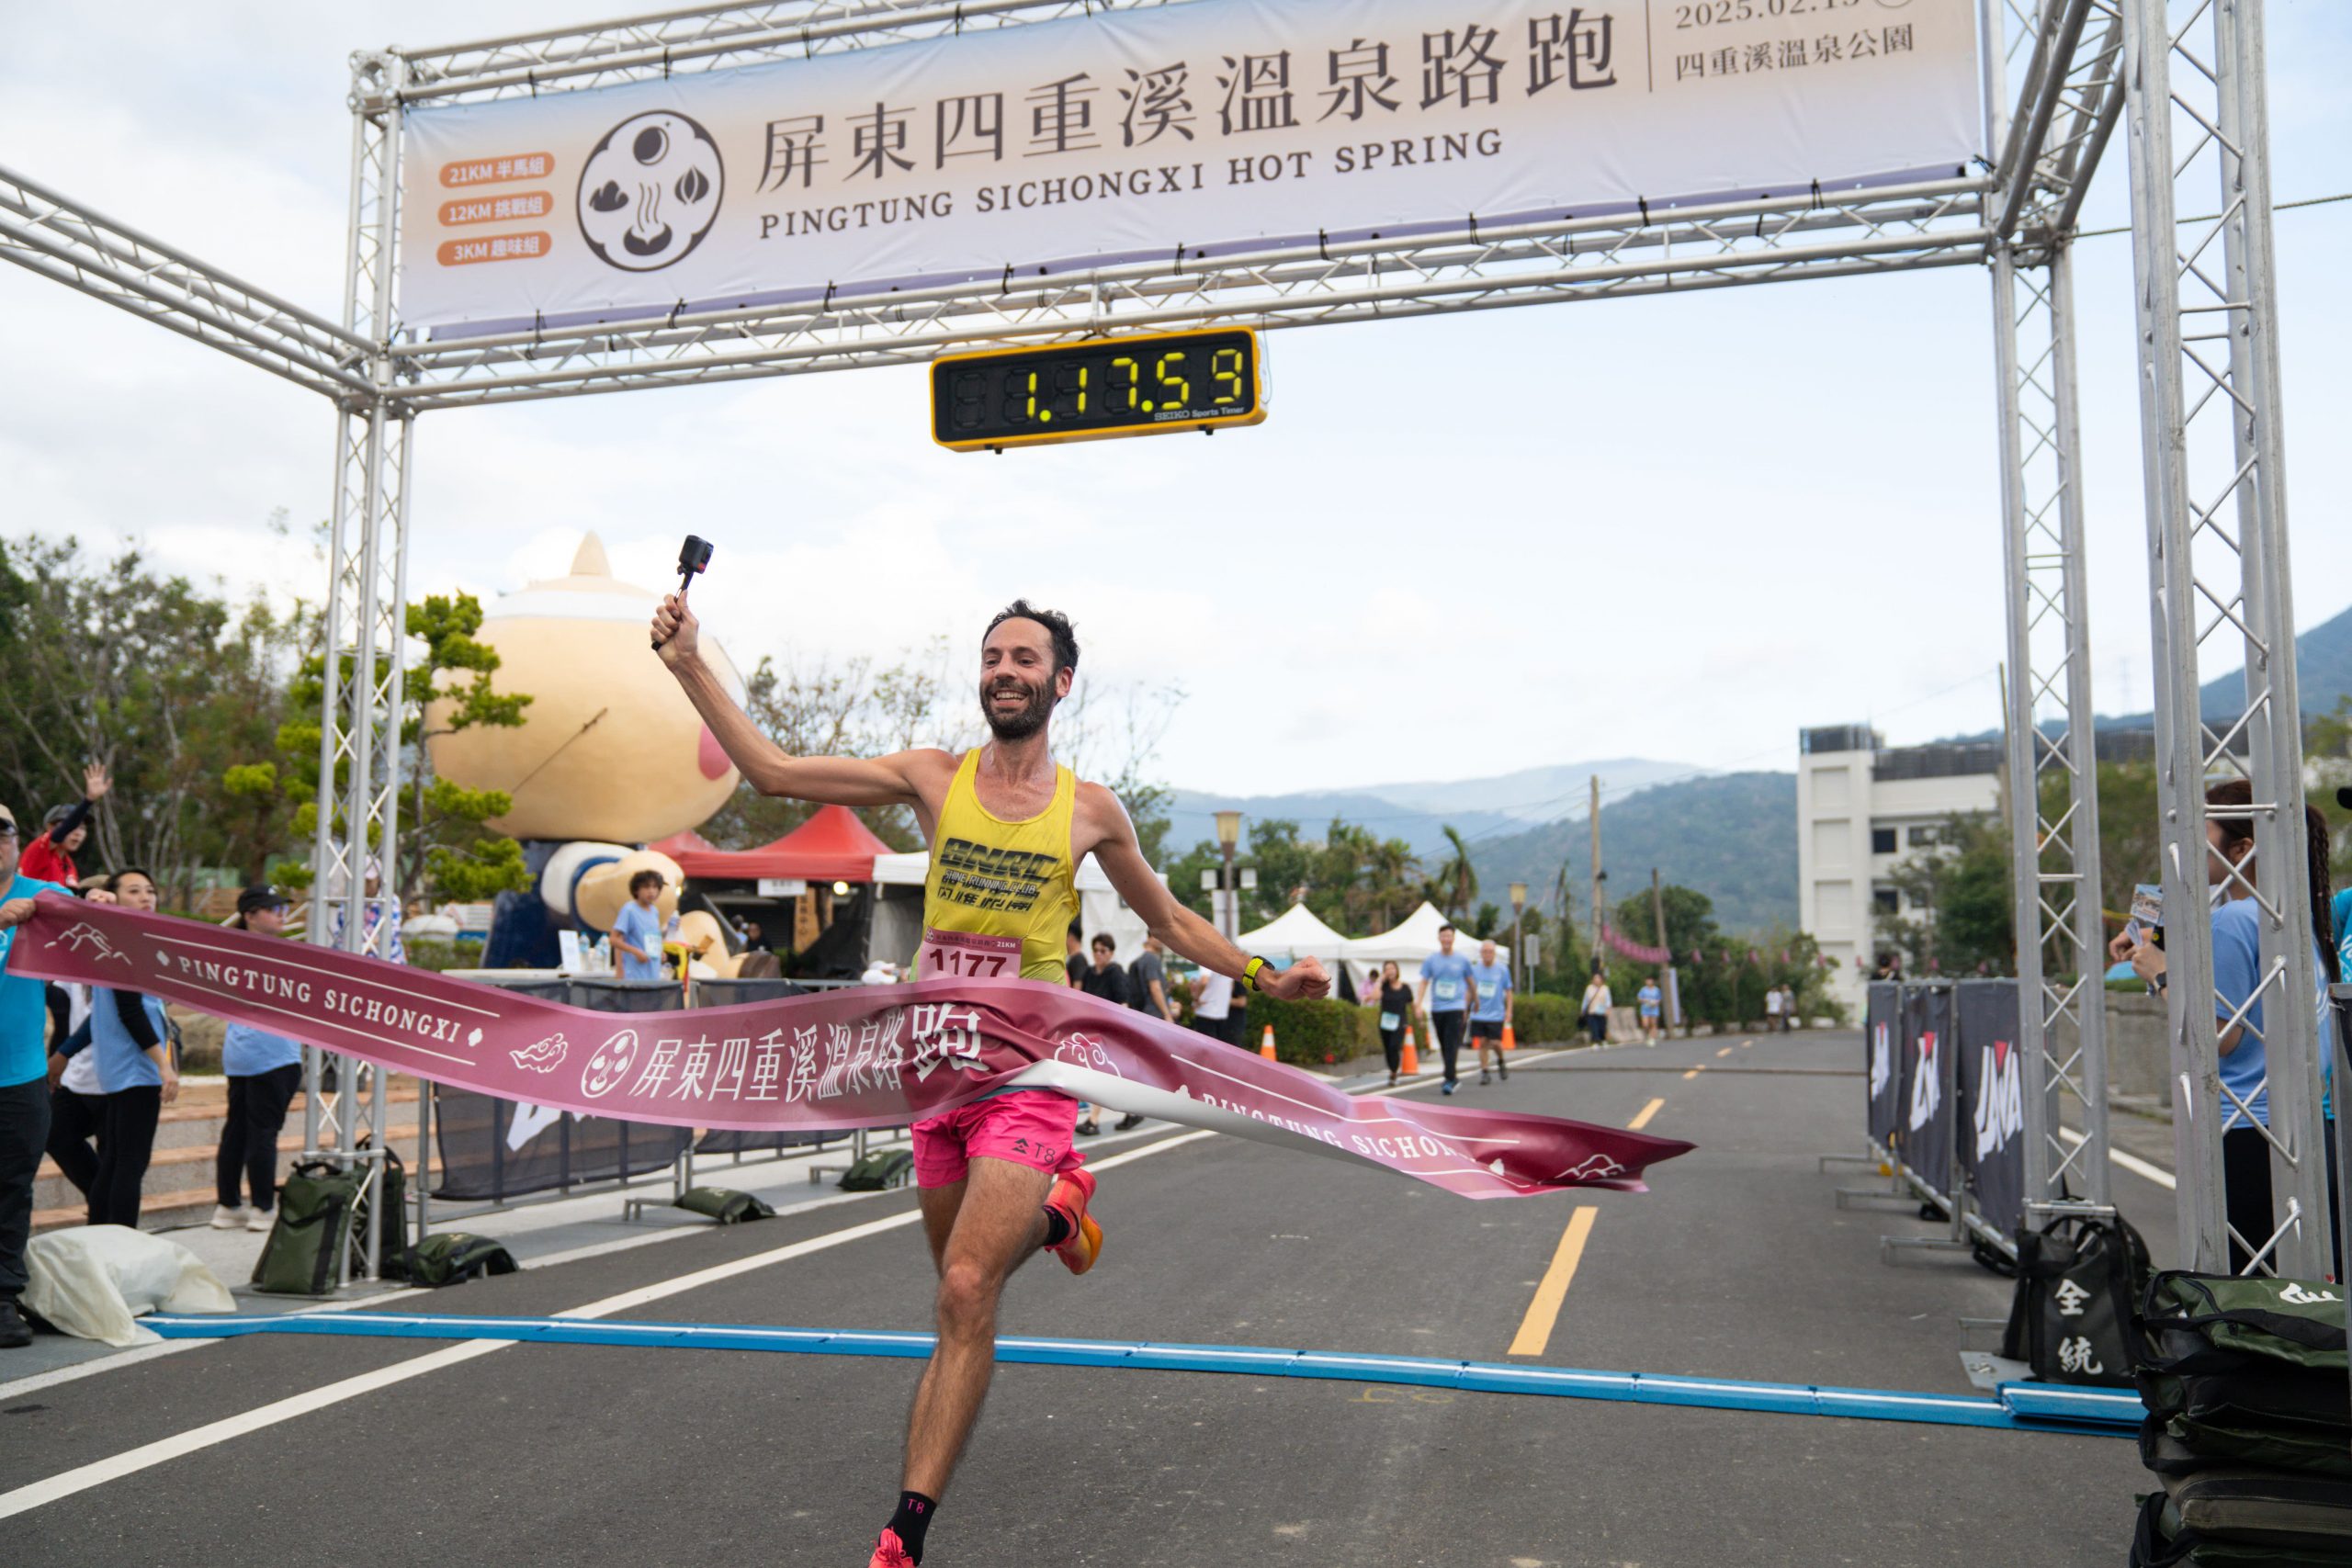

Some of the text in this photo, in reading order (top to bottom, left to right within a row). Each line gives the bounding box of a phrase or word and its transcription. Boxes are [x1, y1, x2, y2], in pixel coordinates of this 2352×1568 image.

[1675, 0, 1860, 29] 2025.02.
[1675, 23, 1914, 82] 四重溪溫泉公園
[756, 8, 1618, 194] 屏東四重溪溫泉路跑
[449, 164, 493, 184] 21KM
[760, 129, 1503, 239] PINGTUNG SICHONGXI HOT SPRING
[449, 203, 492, 221] 12KM
[454, 242, 488, 262] 3KM
[1154, 406, 1244, 422] SEIKO Sports Timer
[944, 869, 1036, 894] SHINE RUNNING CLUB
[996, 941, 1016, 949] 21KM
[930, 949, 1007, 978] 1177
[177, 956, 461, 1043] PINGTUNG SICHONGXI
[628, 1002, 991, 1103] 屏東四重溪溫泉路跑
[1035, 1142, 1057, 1164] T8
[2054, 1278, 2104, 1375] 全統
[908, 1498, 925, 1514] T8
